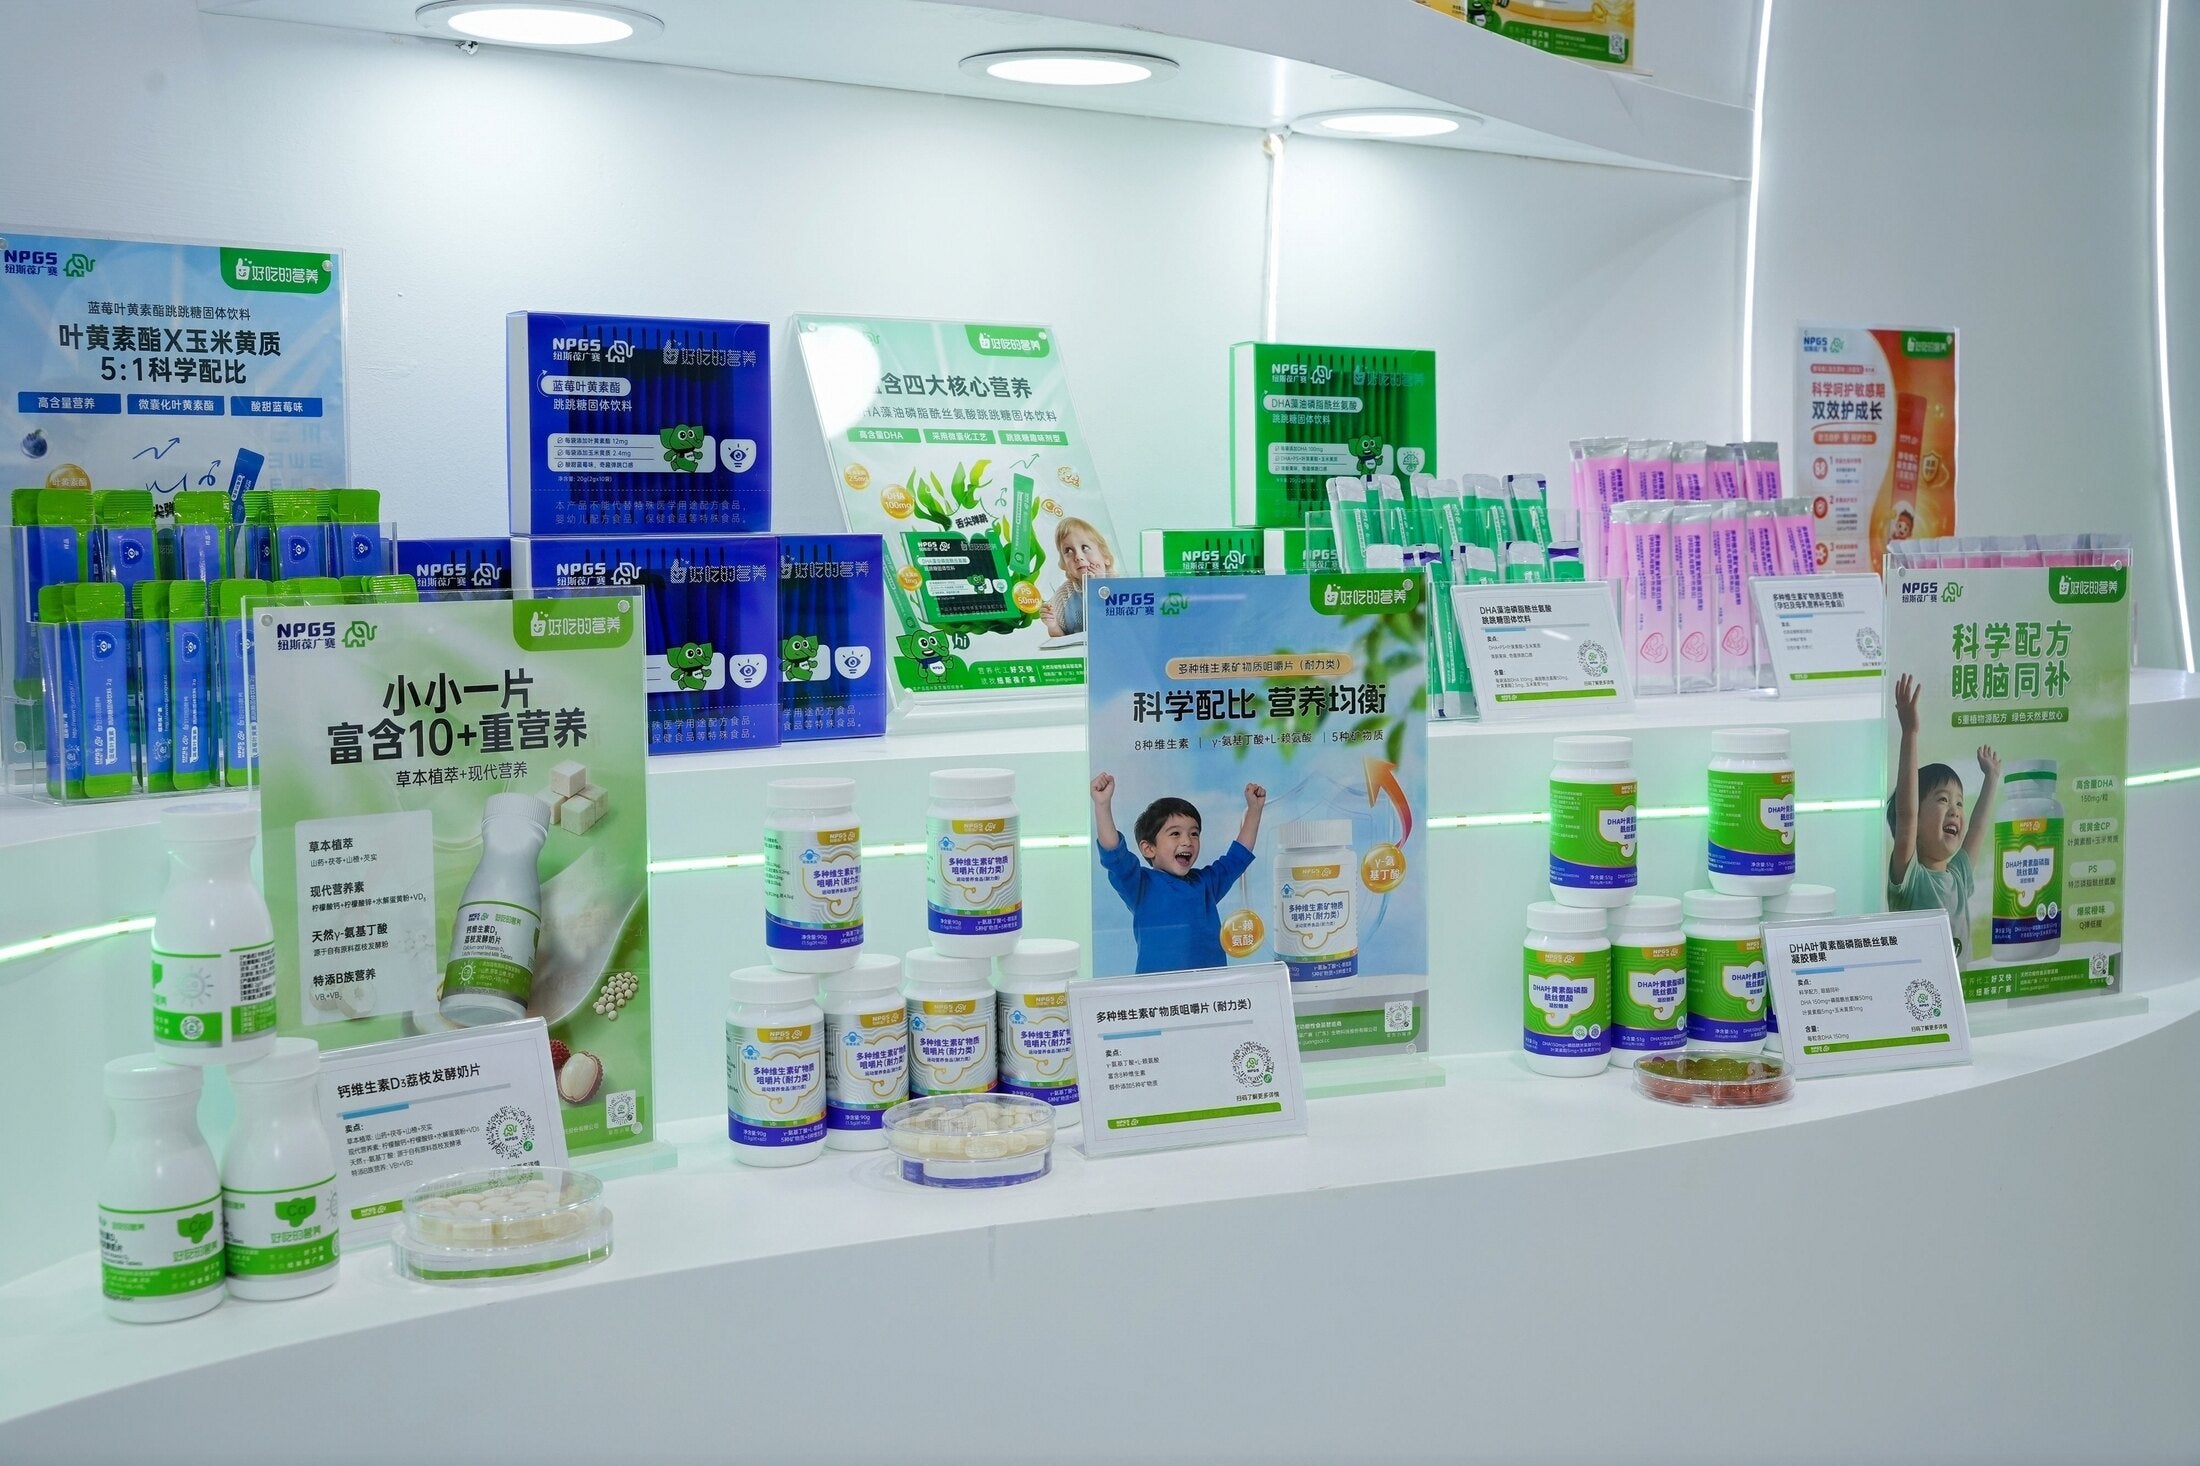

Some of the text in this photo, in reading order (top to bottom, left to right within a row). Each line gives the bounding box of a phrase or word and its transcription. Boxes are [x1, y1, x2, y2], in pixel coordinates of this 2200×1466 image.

[4, 250, 58, 265] NPGS
[4, 264, 59, 277] 纽斯葆广赛
[252, 265, 319, 284] 好吃的营养
[87, 300, 251, 321] 蓝莓叶黄素酯跳跳糖固体饮料
[59, 324, 281, 357] 叶黄素酯X玉米黄质
[552, 338, 601, 351] NPGS
[991, 337, 1041, 352] 好吃的营养
[1803, 336, 1828, 346] NPGS
[552, 351, 601, 362] 纽斯葆广赛
[682, 348, 757, 368] 好吃的营养
[101, 357, 247, 384] 5:1科学配比
[1272, 364, 1308, 375] NPGS
[552, 379, 621, 394] 蓝莓叶黄素酯
[1811, 382, 1886, 399] 科学呵护敏感期
[38, 396, 95, 410] 高含量营养
[138, 398, 215, 412] 微囊化叶黄素酯
[251, 400, 304, 413] 酸甜蓝莓味
[553, 398, 632, 412] 跳跳糖固体饮料
[1271, 398, 1358, 412] DHA藻油磷脂酰丝氨酸
[1811, 400, 1883, 421] 双效护成长
[1272, 414, 1331, 425] 跳跳糖固体饮料
[612, 437, 629, 446] 12mg
[858, 430, 904, 441] 高含量DHA
[612, 449, 631, 457] 2.4mg
[886, 500, 911, 510] 100mg
[955, 513, 989, 529] 舌尖弹跳
[1182, 551, 1220, 562] NPGS
[417, 563, 467, 576] NPGS
[556, 563, 606, 576] NPGS
[688, 564, 767, 585] 好吃的营养
[791, 562, 870, 581] 好吃的营养
[1902, 582, 1938, 594] NPGS
[2070, 581, 2118, 595] 好吃的营养
[1017, 596, 1040, 605] 50mg
[1105, 593, 1155, 606] NPGS
[1340, 590, 1407, 605] 好吃的营养
[1902, 594, 1938, 604] 纽斯葆广赛
[1105, 605, 1155, 617] 纽斯葆广赛
[1480, 604, 1553, 616] DHA藻油磷脂酰丝氨酸
[548, 616, 621, 638] 好吃的营养
[1482, 615, 1532, 626] 跳跳糖固体饮料
[277, 621, 336, 639] NPGS
[277, 637, 337, 652] 纽斯葆广赛
[953, 633, 968, 648] hi
[1951, 620, 2072, 661] 科学配方
[1951, 660, 2071, 700] 眼脑同补
[382, 667, 534, 717] 小小一片
[1133, 683, 1387, 723] 科学配比 营养均衡
[1957, 711, 2064, 725] 5重植物源配方 绿色天然更放心
[326, 707, 589, 766] 富含10+重营养
[1134, 737, 1190, 751] 8种维生素
[1331, 729, 1385, 743] 5种矿物质
[395, 761, 529, 789] 草本植萃+现代营养
[2076, 779, 2114, 790] 高含量DHA
[308, 838, 354, 853] 草本植萃
[948, 856, 1009, 867] 多种维生素矿物质
[951, 865, 1005, 876] 咀嚼片(耐力类)
[1369, 869, 1400, 881] 基丁酸
[2088, 865, 2098, 874] PS
[310, 881, 365, 899] 现代营养素
[1288, 901, 1344, 913] 多种维生素矿物质
[312, 923, 388, 944] 天然γ-氨基丁酸
[1231, 934, 1254, 947] 氨酸
[1789, 935, 1899, 954] DHA叶黄素酯磷脂酰丝氨酸
[1790, 951, 1828, 965] 凝胶糖果
[313, 968, 377, 987] 特添B族营养
[1532, 984, 1588, 994] DHA叶黄素酯磷脂
[1652, 988, 1678, 997] 酰丝氨酸
[1544, 994, 1574, 1002] 酰丝氨酸
[919, 1035, 980, 1047] 多种维生素矿物质
[922, 1045, 976, 1057] 咀嚼片(耐力类)
[753, 1062, 815, 1076] 多种维生素矿物质
[1107, 1069, 1146, 1081] 富含8种维生素
[336, 1062, 481, 1100] 钙维生素D3荔枝发酵奶片
[756, 1074, 811, 1085] 咀嚼片(耐力类)
[1108, 1079, 1159, 1092] 额外添加5种矿物质
[270, 1225, 322, 1244] 好吃的营养
